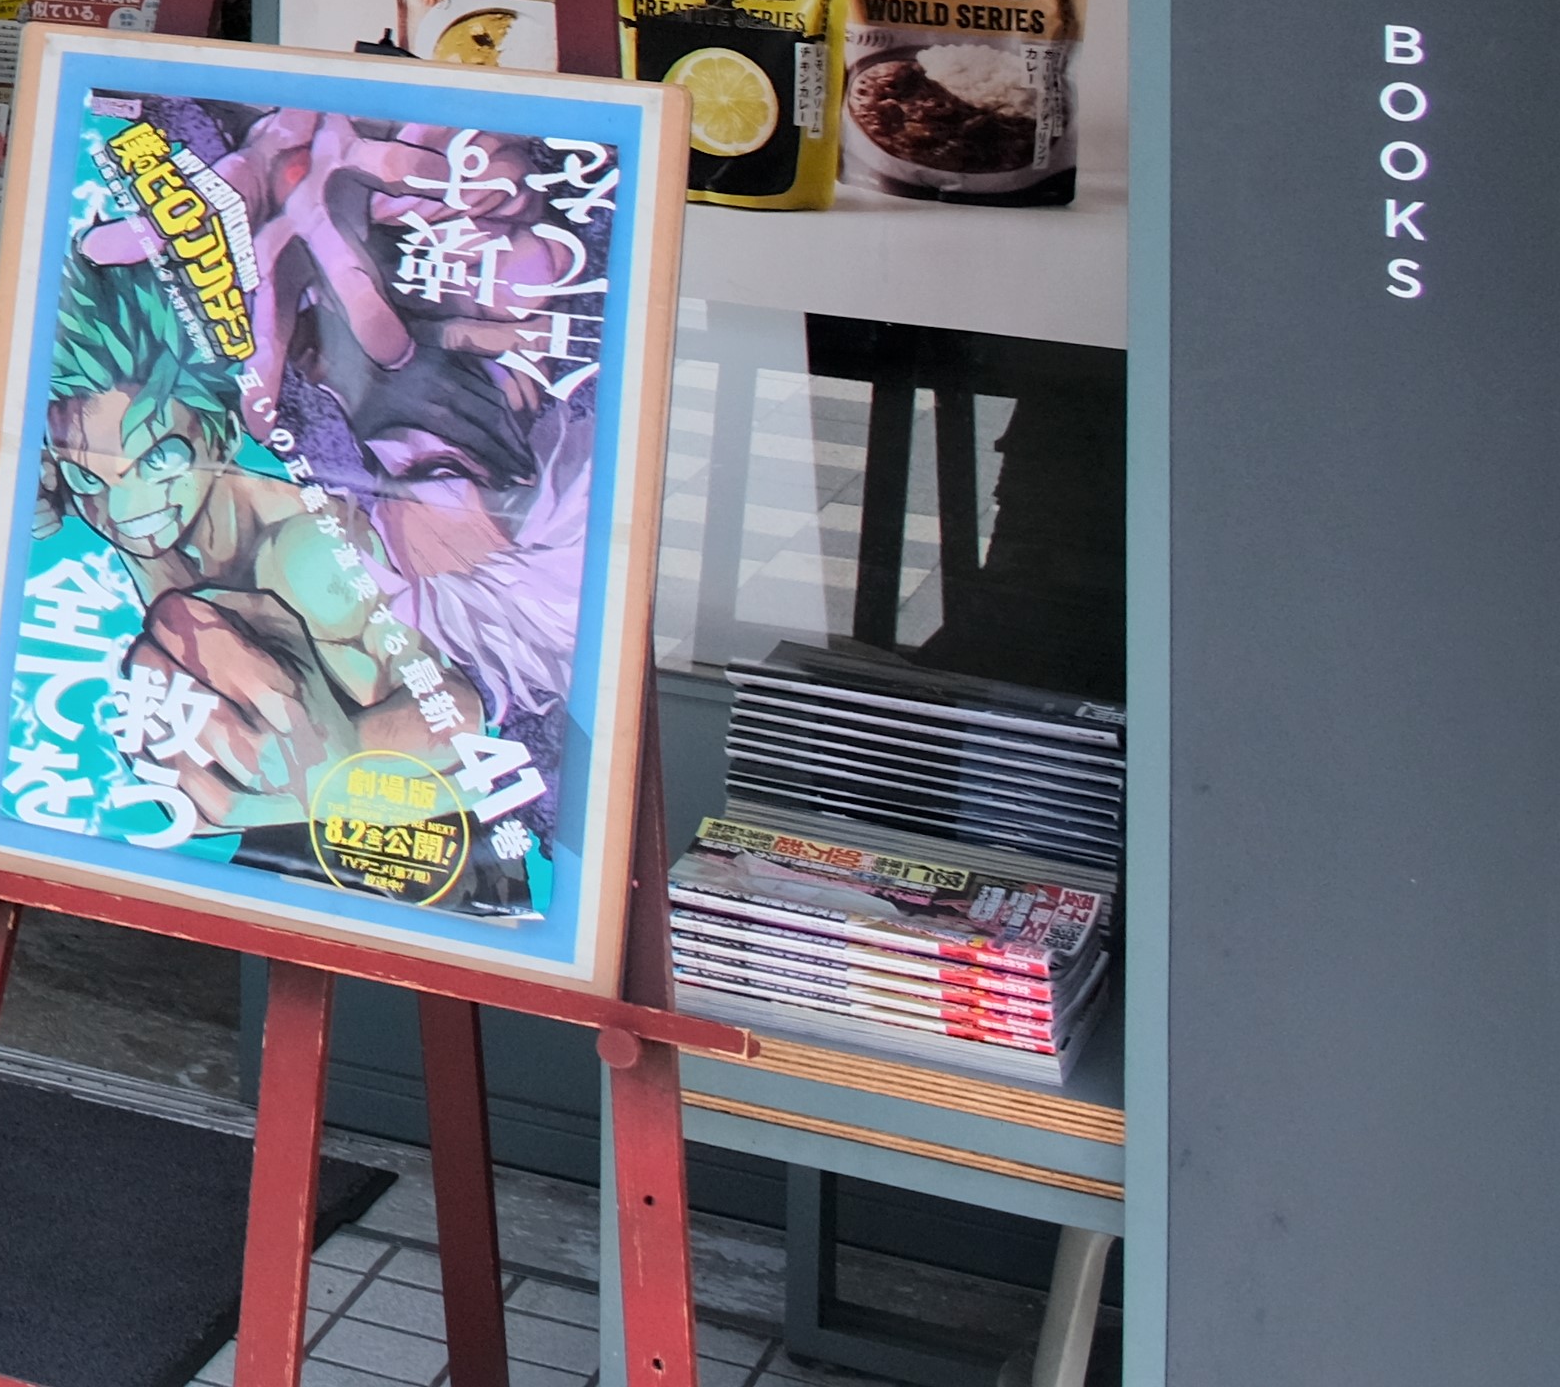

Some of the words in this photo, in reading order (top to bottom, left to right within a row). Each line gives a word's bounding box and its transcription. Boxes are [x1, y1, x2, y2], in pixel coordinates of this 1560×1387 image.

[32, 3, 101, 22] 似ている。
[956, 4, 1047, 35] SERIES
[1381, 24, 1429, 300] BOOKS
[0, 560, 119, 838] 全てを
[107, 664, 221, 848] 救う
[347, 767, 437, 811] 劇場版
